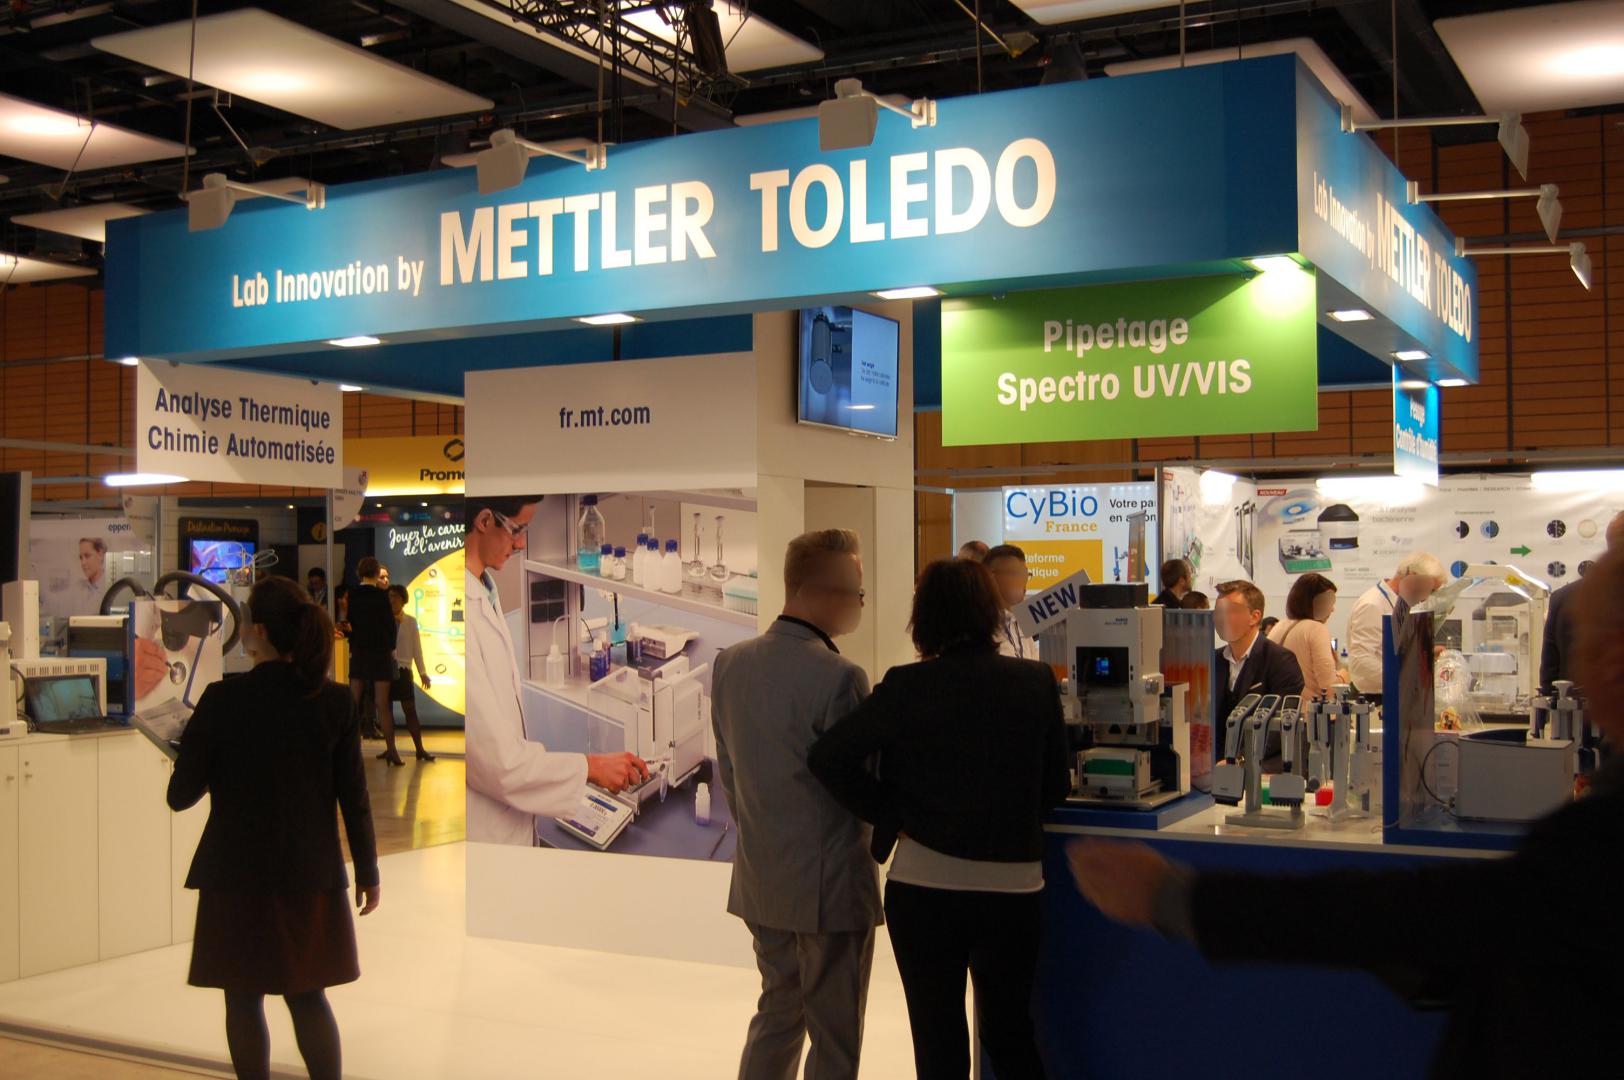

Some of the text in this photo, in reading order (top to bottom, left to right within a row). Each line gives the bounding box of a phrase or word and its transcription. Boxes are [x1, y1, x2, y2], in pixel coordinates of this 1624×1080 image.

[232, 137, 1057, 307] Lab Innovation by METTLER TOLEDO
[1313, 170, 1328, 222] Lab
[1376, 191, 1432, 311] METTLER
[1434, 251, 1473, 344] TOLEDO
[1043, 317, 1189, 358] Pipetage
[997, 358, 1252, 412] Spectro UV/VIS
[155, 387, 331, 432] Analyse Thermique
[559, 405, 651, 429] fr.mt.com
[148, 425, 335, 465] Chimie Automatisée
[1006, 490, 1098, 524] CyBio
[1109, 499, 1138, 509] Votre
[1109, 514, 1123, 522] en
[389, 527, 420, 549] Jouez
[422, 524, 436, 538] la
[1045, 521, 1098, 533] France
[403, 536, 465, 556] de l'avenir
[1025, 553, 1065, 564] teforme
[1028, 583, 1077, 624] NEW
